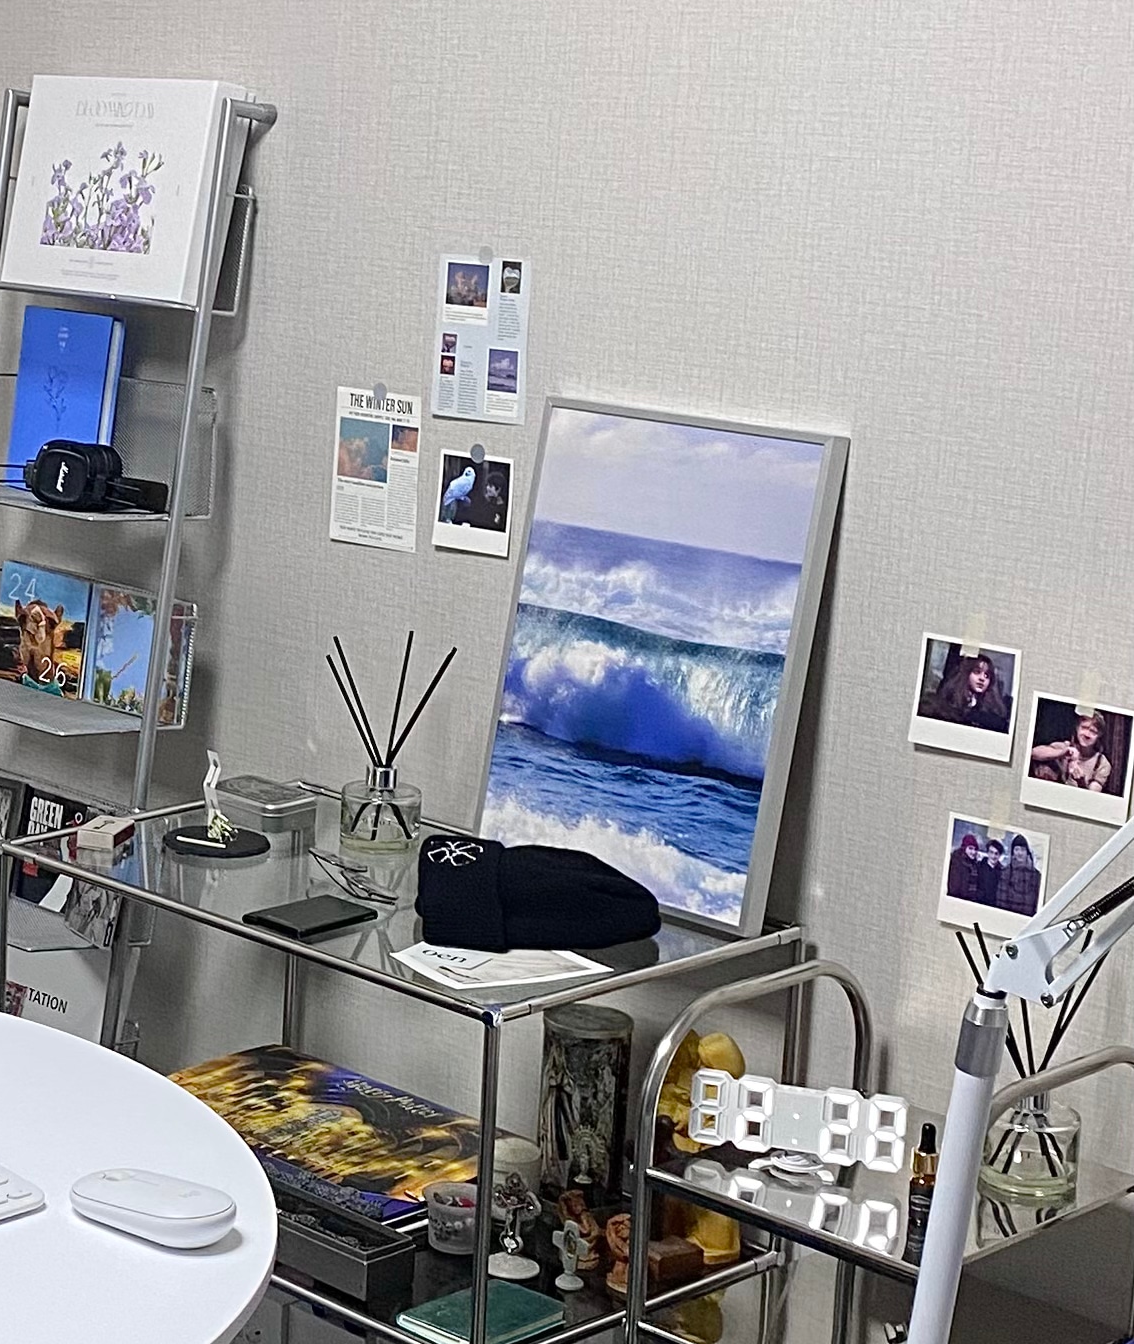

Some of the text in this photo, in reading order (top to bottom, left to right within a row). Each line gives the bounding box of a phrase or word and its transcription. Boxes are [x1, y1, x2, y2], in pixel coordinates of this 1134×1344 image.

[350, 392, 413, 415] THE WINTER SUN
[38, 656, 68, 687] 26
[29, 796, 64, 830] GREEN
